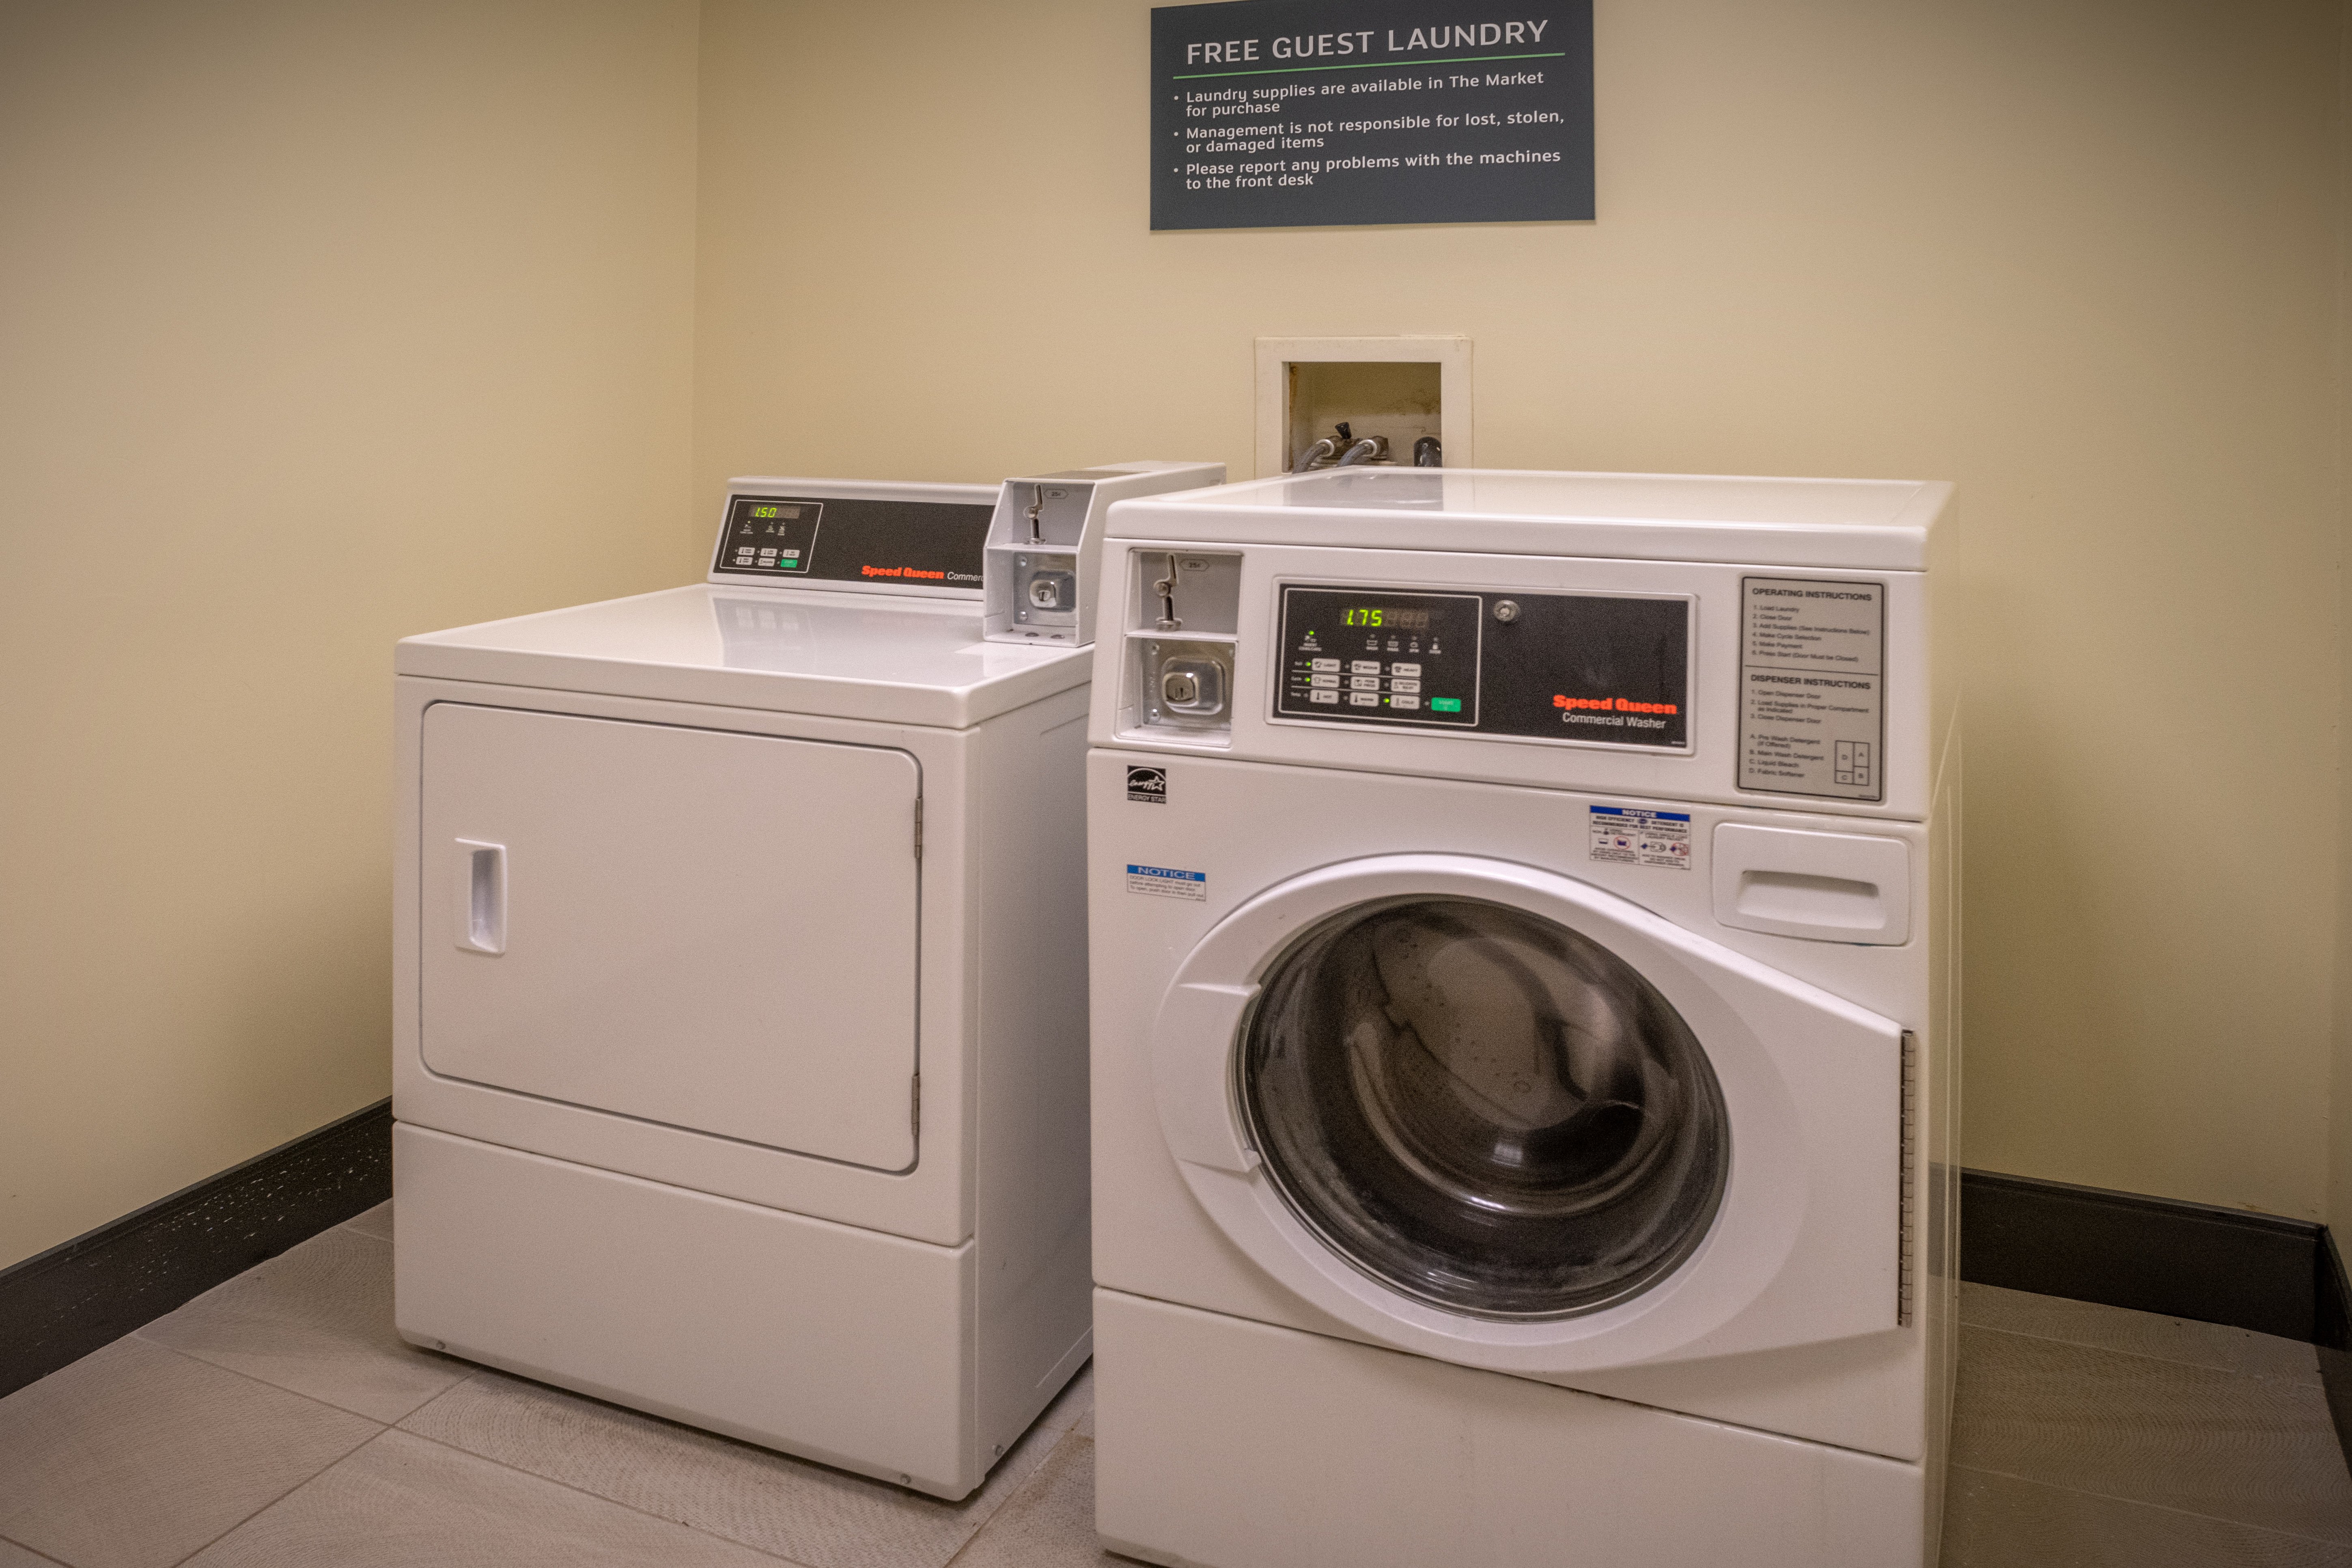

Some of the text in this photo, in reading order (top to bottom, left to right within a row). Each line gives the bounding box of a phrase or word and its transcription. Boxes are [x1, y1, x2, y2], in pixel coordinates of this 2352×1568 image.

[1188, 19, 1548, 65] FREE GUEST LAUNDRY
[1187, 72, 1544, 103] Laundry supplies are available in The Market
[1186, 102, 1280, 118] for purchase
[1187, 110, 1564, 140] Management is not responsible for lost, stolen,
[1186, 137, 1324, 153] or damaged items
[1187, 150, 1561, 175] Please report any problems with the machines
[1186, 173, 1314, 190] to the front desk
[862, 565, 902, 577] Speed
[904, 567, 944, 579] Queen
[1752, 588, 1872, 601] OPERATING INSTRUCTIONS
[1751, 674, 1871, 689] DISPENSER INSTRUCTIONS
[1553, 695, 1677, 715] Speed Queen
[1562, 712, 1666, 728] Commercial Washer
[1622, 809, 1657, 817] NOTICE
[1138, 867, 1195, 879] NOTICE
